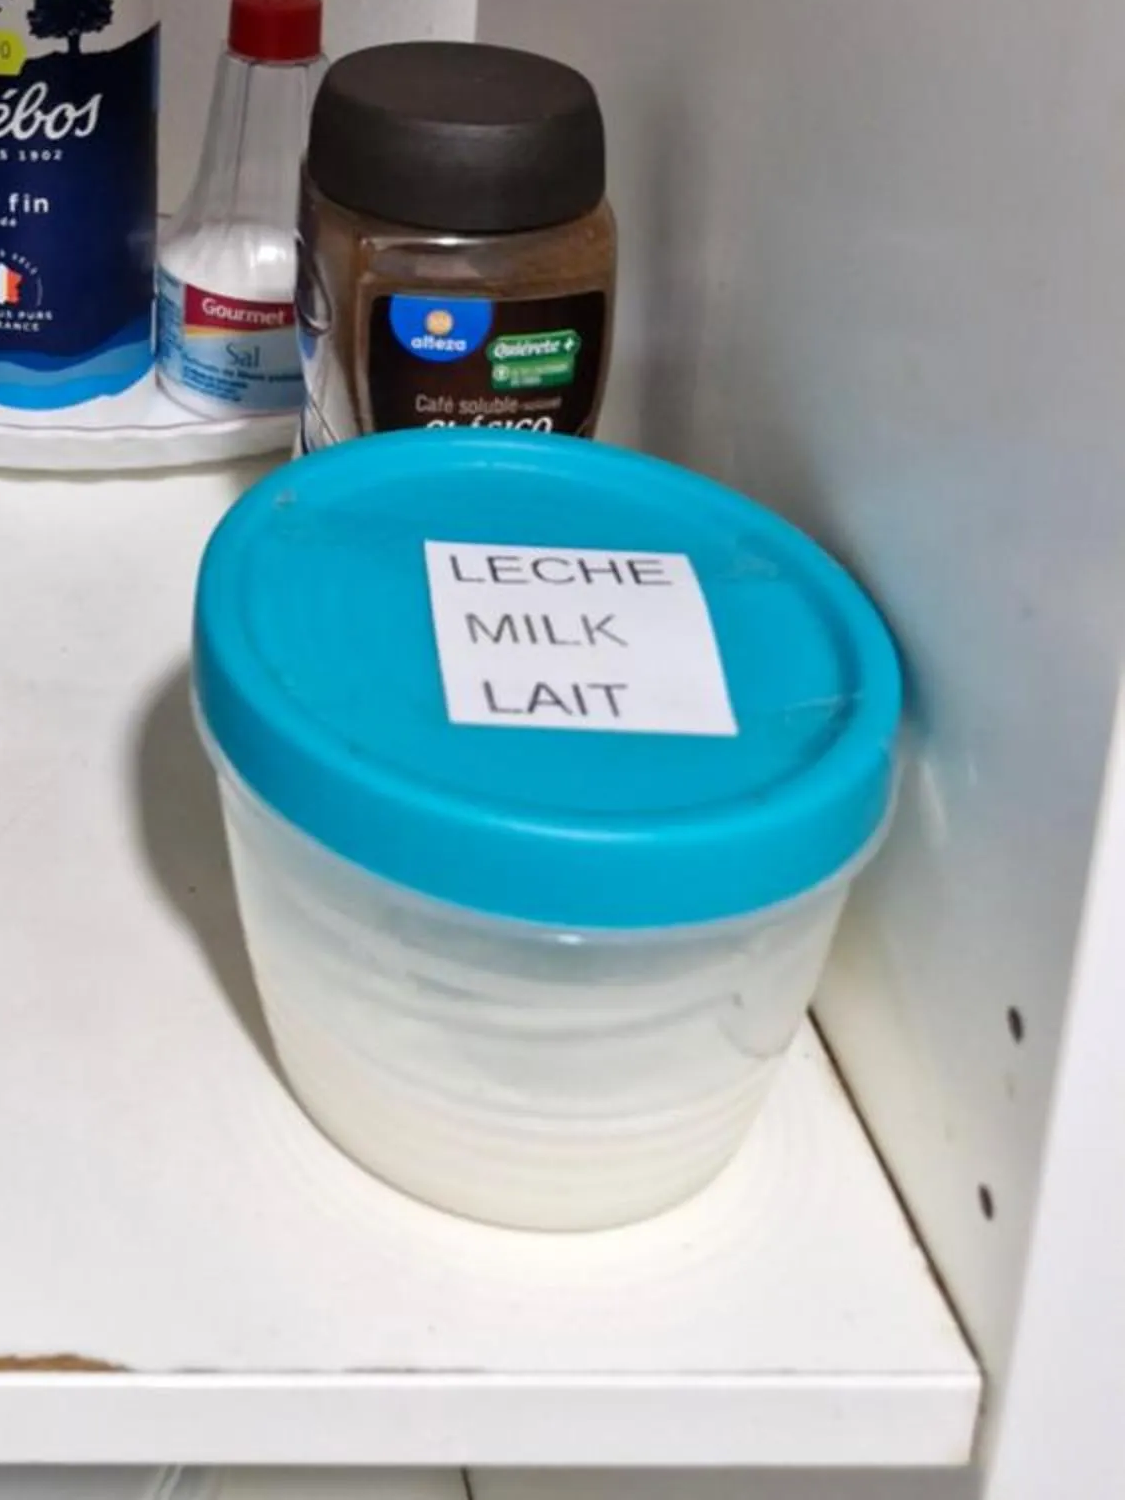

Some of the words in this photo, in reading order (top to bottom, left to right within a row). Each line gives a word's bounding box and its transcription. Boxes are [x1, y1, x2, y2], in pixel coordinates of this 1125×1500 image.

[18, 148, 64, 162] 1902
[8, 192, 50, 214] fin
[201, 297, 286, 326] Gourmet
[225, 342, 261, 368] Sal
[414, 393, 454, 415] Café
[458, 396, 518, 415] soluble
[449, 553, 673, 587] LECHE
[464, 611, 629, 648] MILK
[481, 678, 629, 719] LAIT
